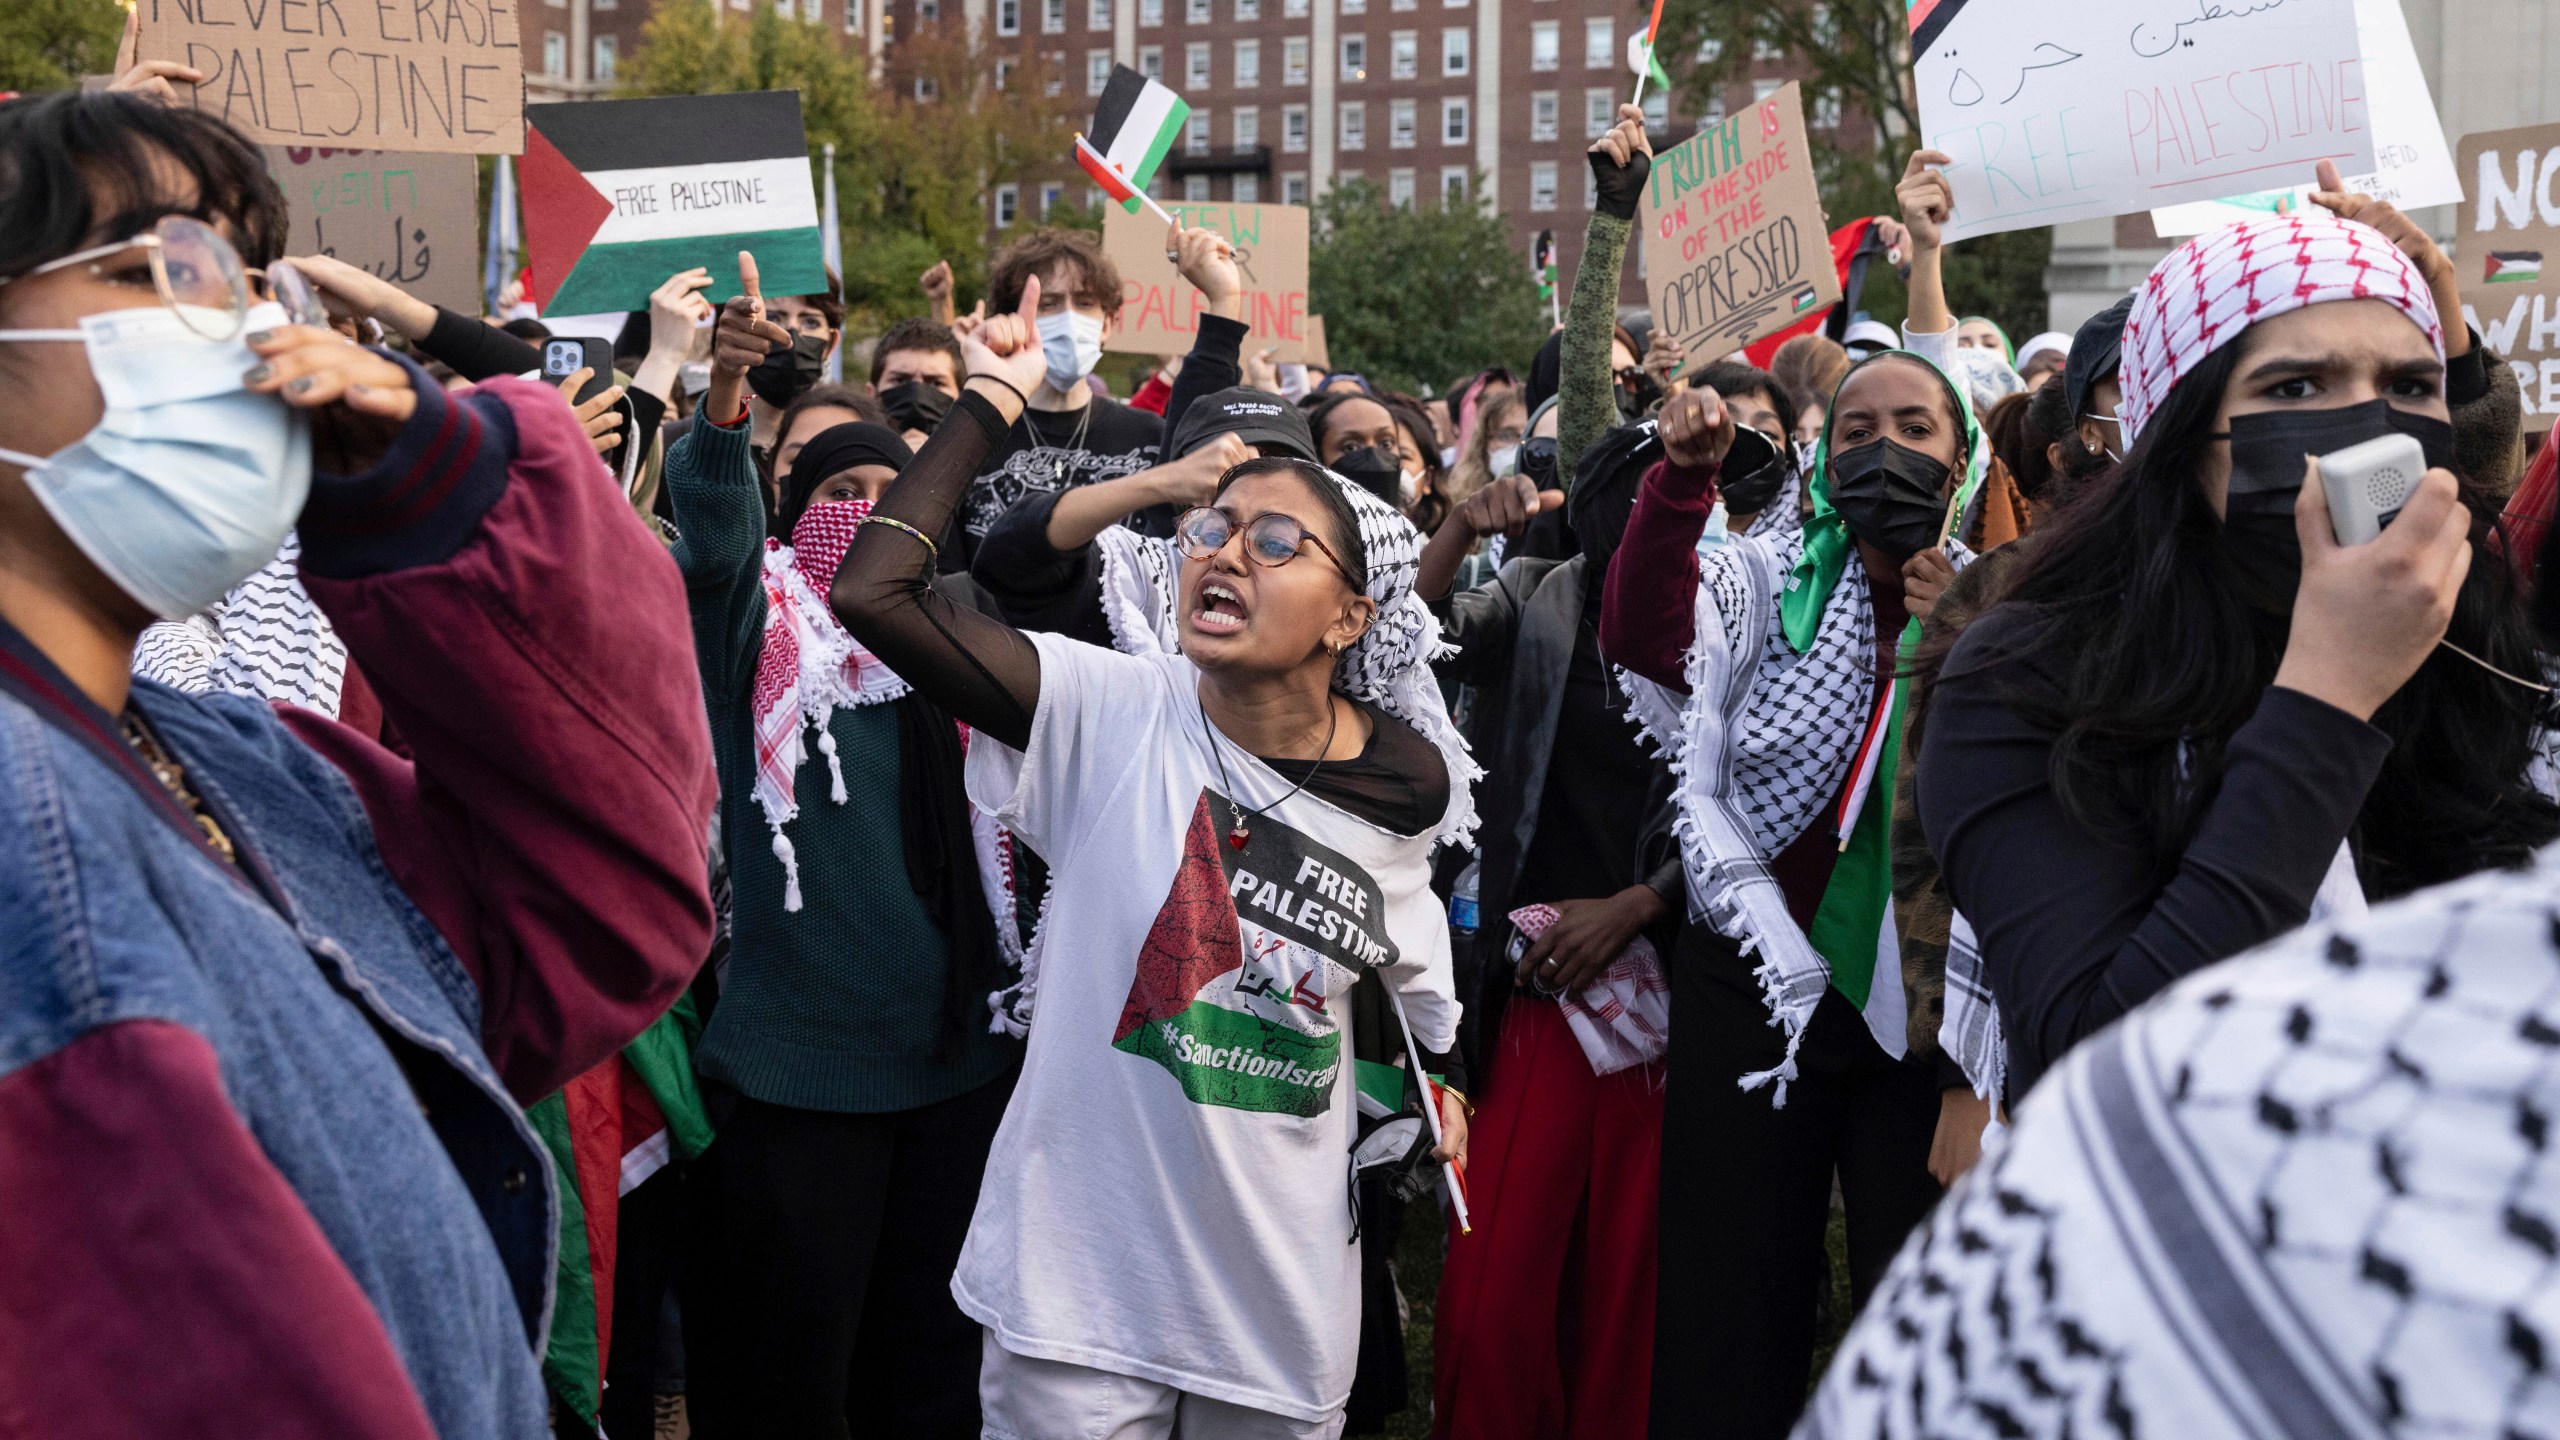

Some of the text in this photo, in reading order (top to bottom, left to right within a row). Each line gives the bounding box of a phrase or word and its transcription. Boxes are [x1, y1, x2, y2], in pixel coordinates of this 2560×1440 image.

[377, 0, 519, 48] ERASE
[186, 42, 501, 139] PALESTINE
[1943, 42, 2084, 107] حرة
[1650, 100, 1781, 210] TRUTH IS
[1933, 58, 2362, 223] FREE PALESTINE
[615, 177, 768, 217] FREE PALESTINE
[1657, 140, 1791, 240] ON THE SIDE
[1681, 191, 1767, 262] OF THE
[1117, 279, 1306, 342] PALEINE
[1662, 214, 1800, 338] OPPRESSED
[1230, 868, 1388, 968] PALESTINE
[1294, 855, 1368, 921] FREE
[1161, 1021, 1340, 1089] #SanctionIsrael
